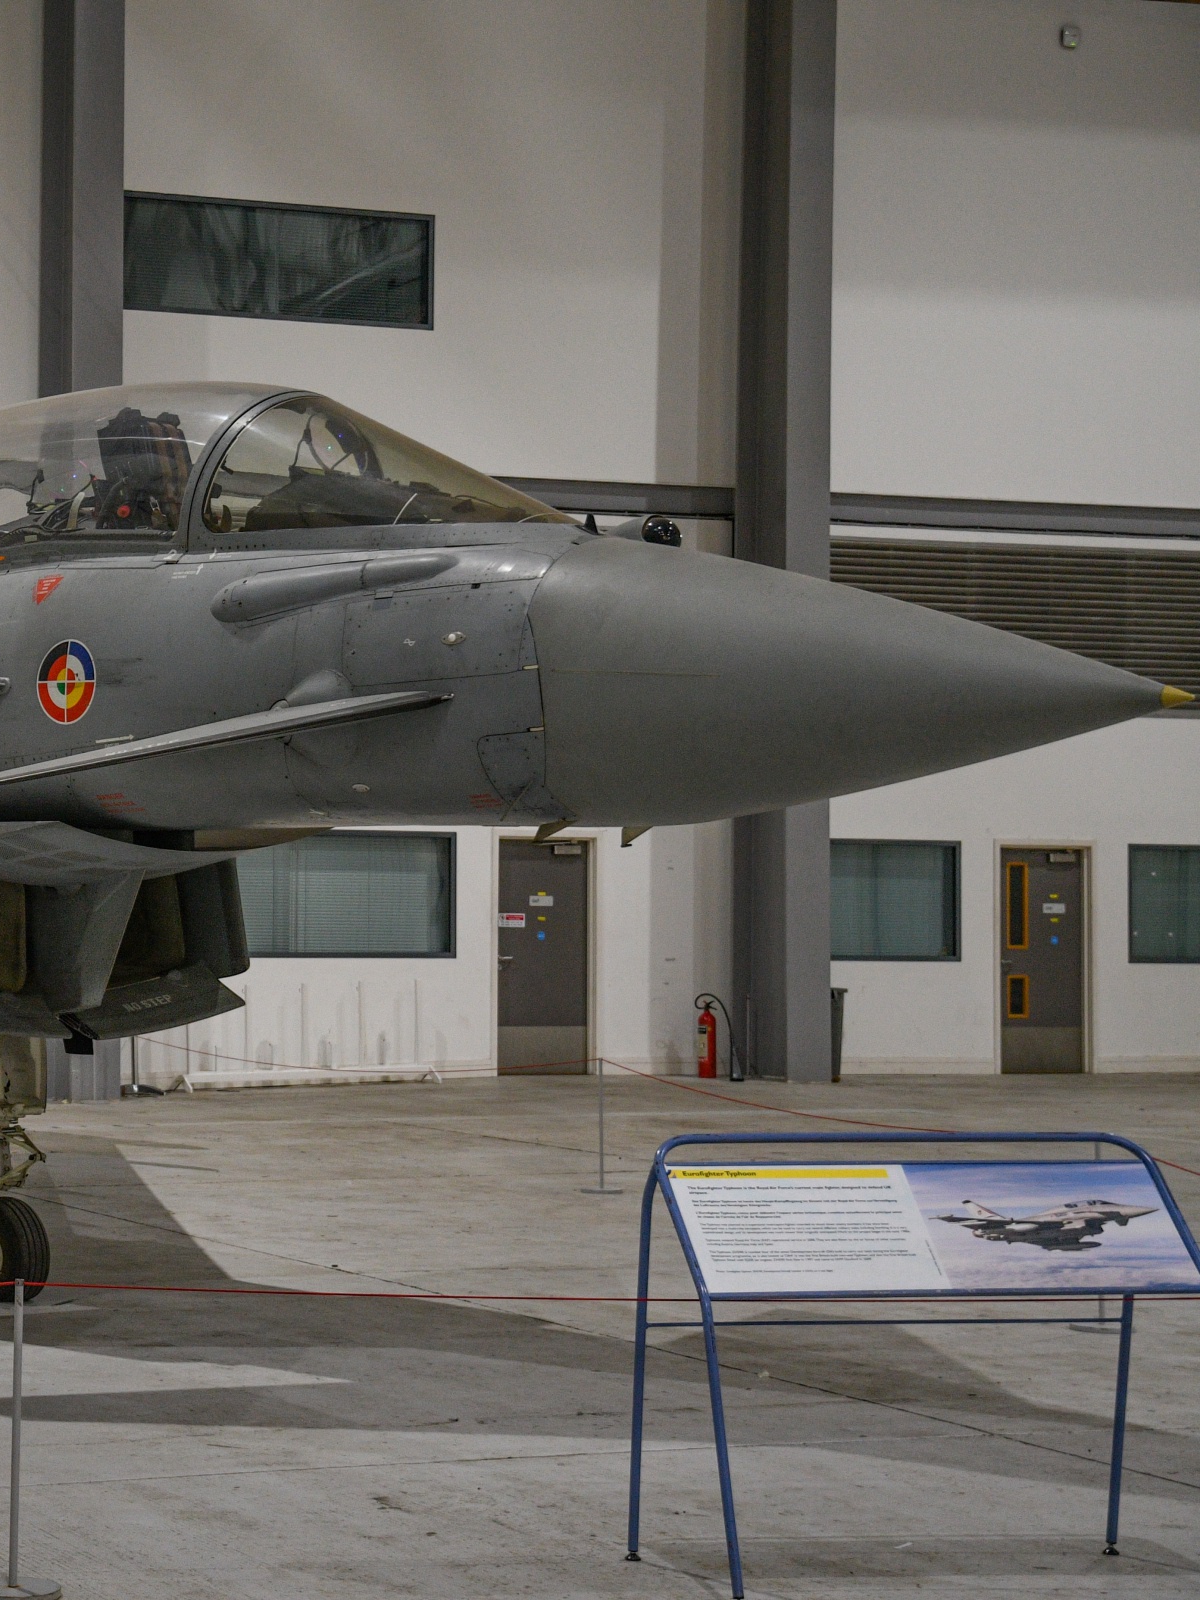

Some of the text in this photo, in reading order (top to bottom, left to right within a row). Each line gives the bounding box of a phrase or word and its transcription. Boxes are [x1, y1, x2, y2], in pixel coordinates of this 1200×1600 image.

[122, 994, 171, 1012] NO STEP
[682, 1170, 757, 1178] Eurofighter Typhoon
